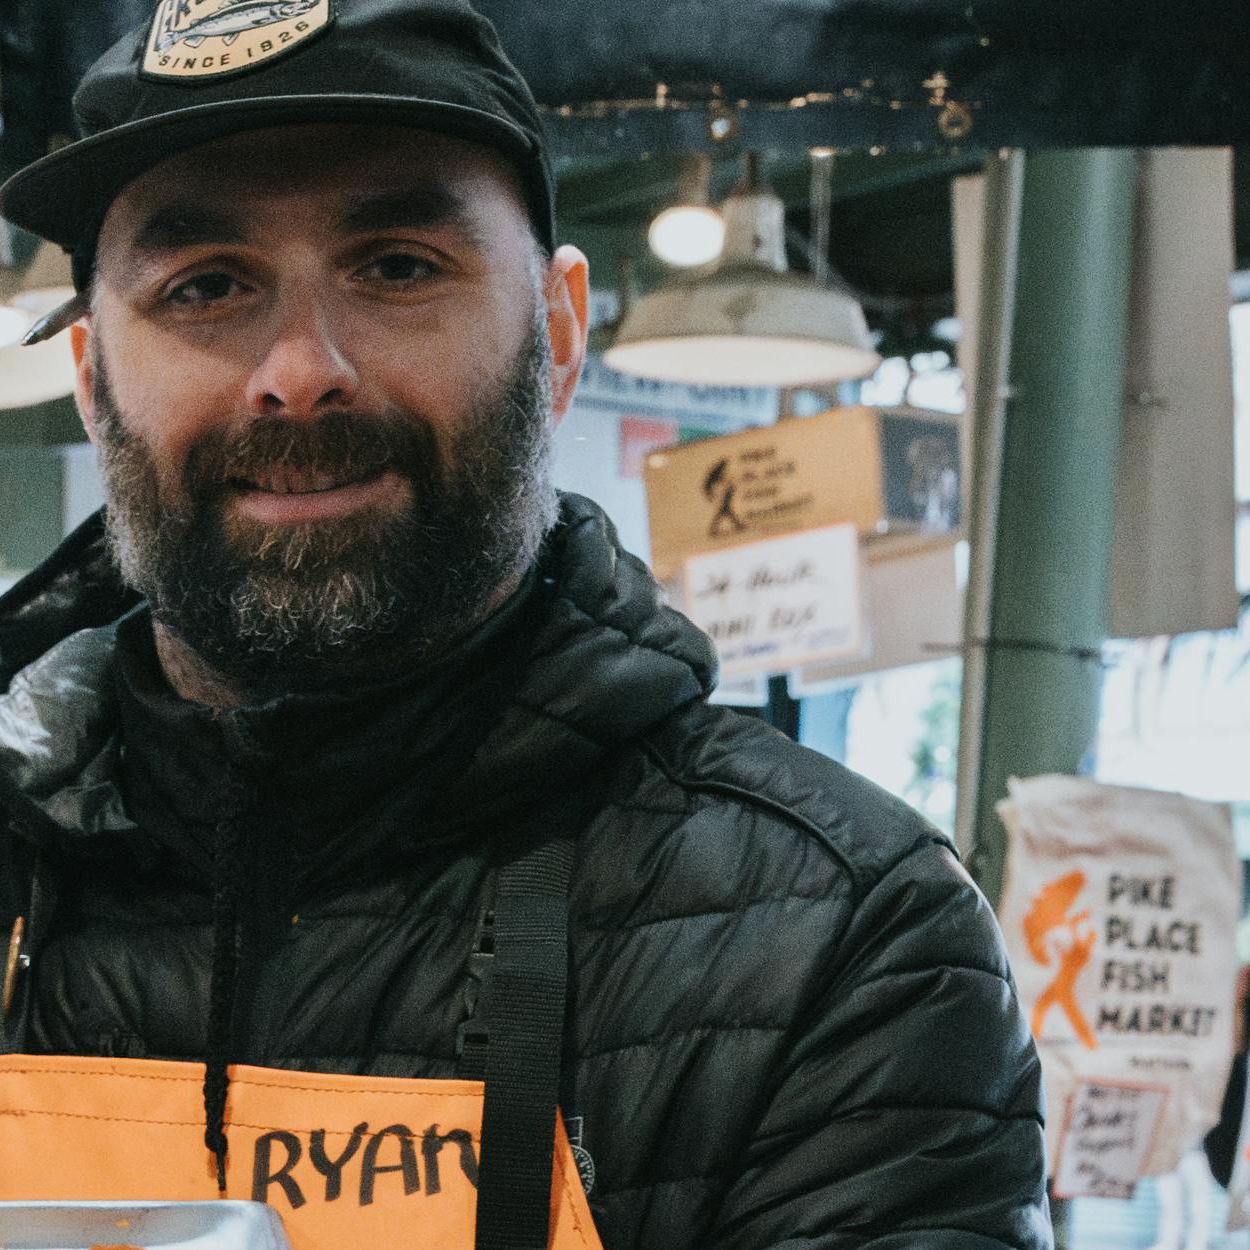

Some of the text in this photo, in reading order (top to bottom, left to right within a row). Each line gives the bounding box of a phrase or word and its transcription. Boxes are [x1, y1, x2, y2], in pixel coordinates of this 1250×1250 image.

[158, 53, 231, 69] SINCE
[1108, 873, 1174, 910] PIKE
[1106, 914, 1201, 954] PLACE
[1101, 958, 1171, 993] FISH
[1096, 1003, 1217, 1037] MARKET
[251, 1121, 479, 1209] RYAN
